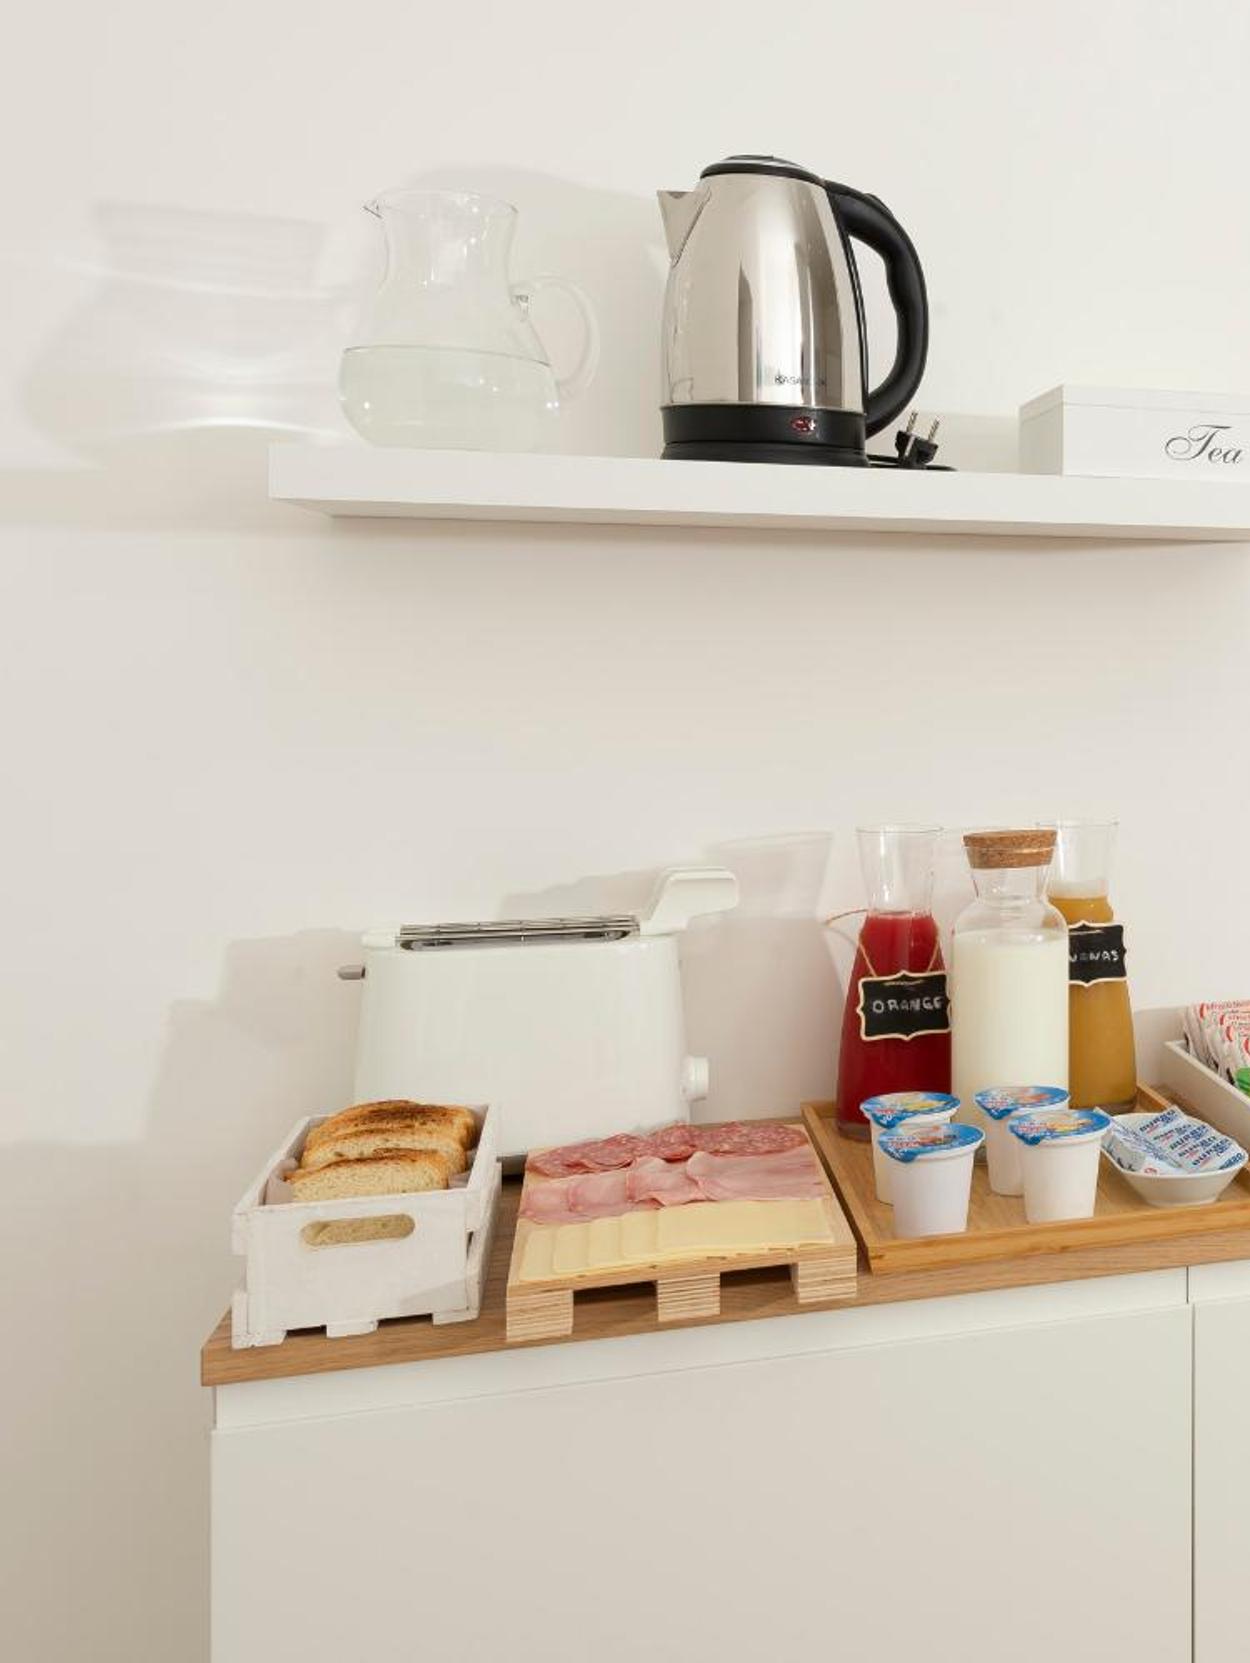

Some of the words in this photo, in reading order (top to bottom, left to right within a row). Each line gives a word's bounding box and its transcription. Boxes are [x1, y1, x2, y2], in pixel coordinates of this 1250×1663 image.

[1165, 424, 1242, 464] Tea
[1069, 950, 1119, 964] NANAS
[871, 996, 944, 1016] ORANGE
